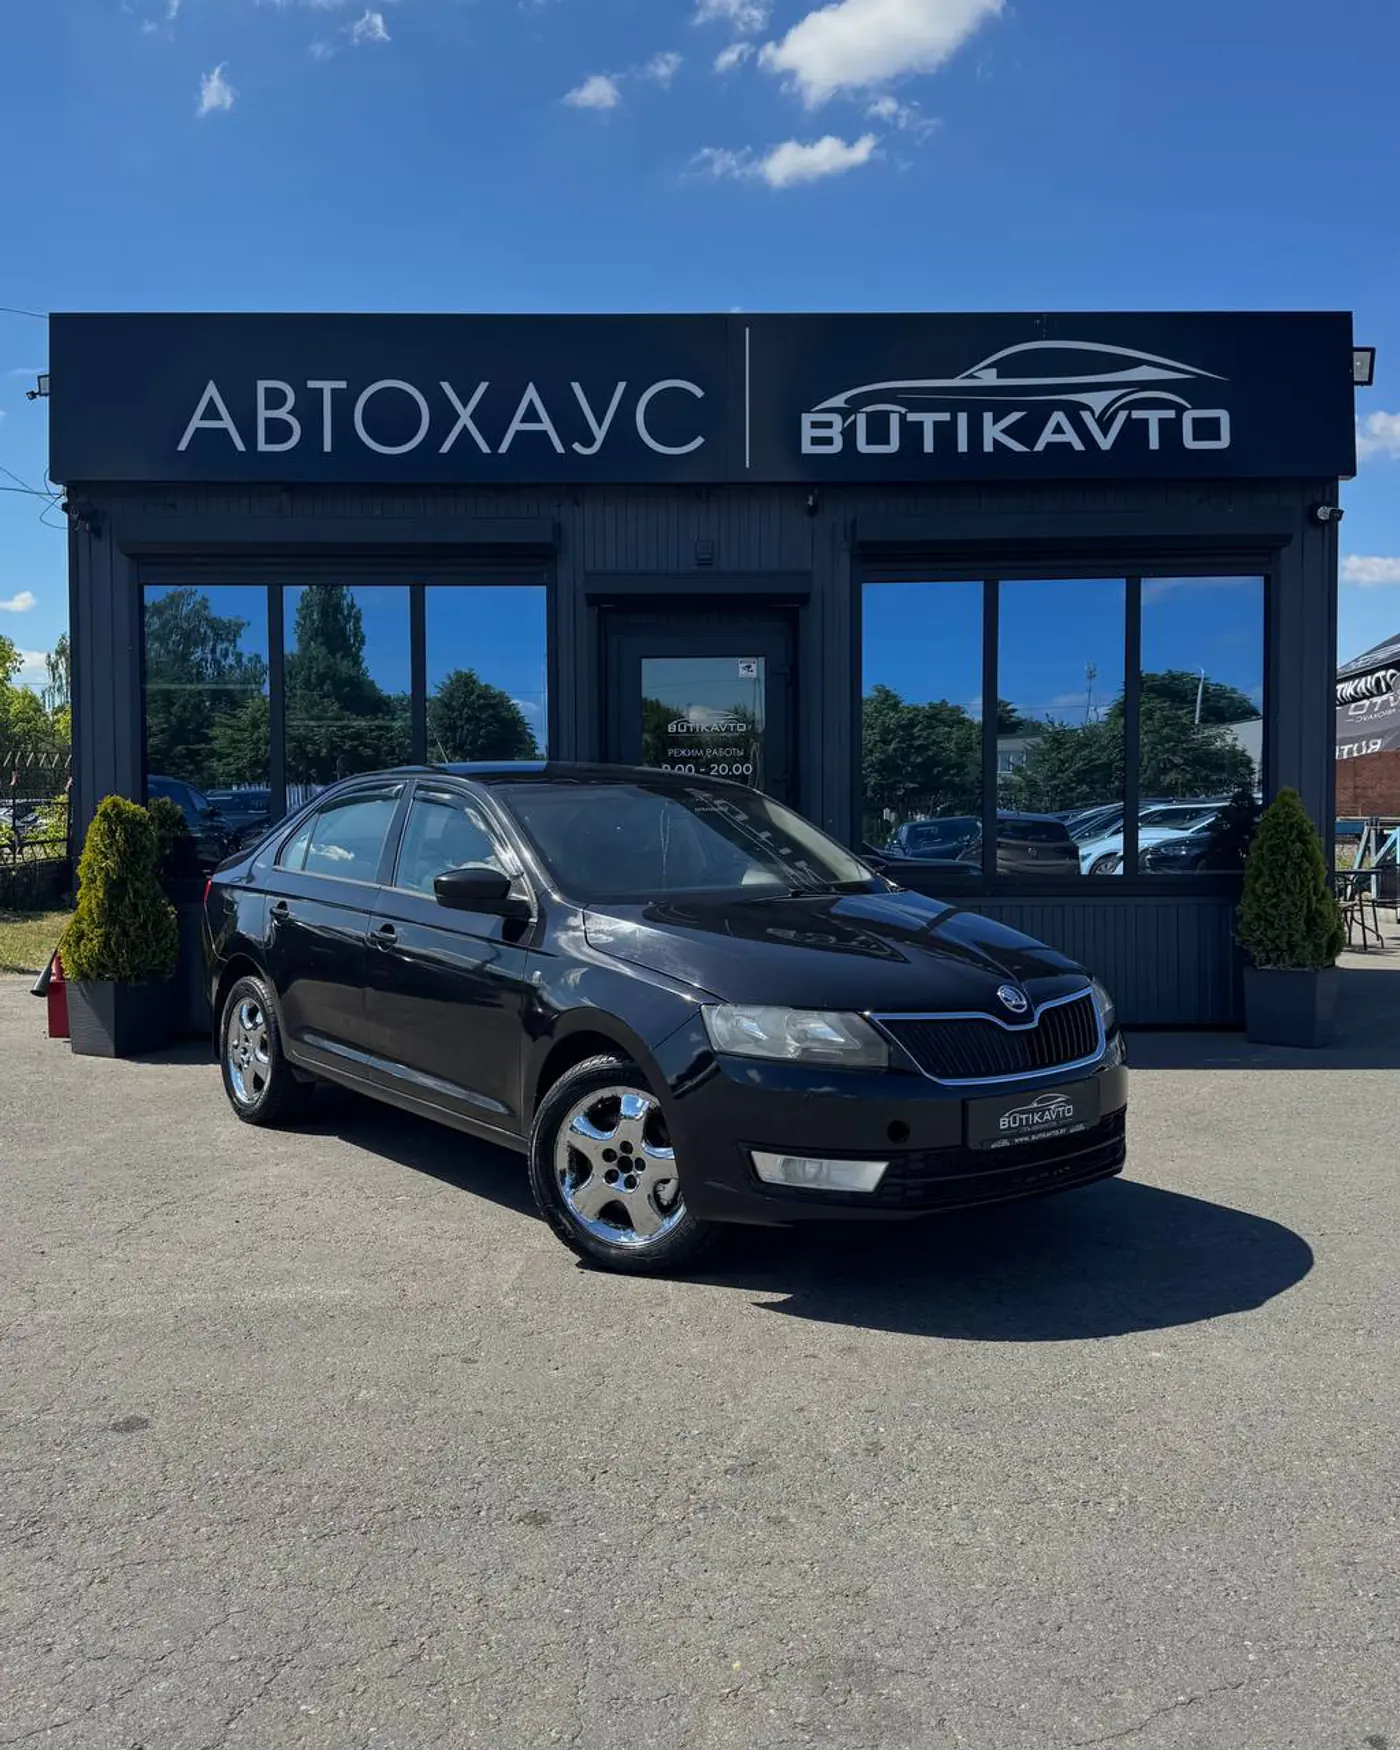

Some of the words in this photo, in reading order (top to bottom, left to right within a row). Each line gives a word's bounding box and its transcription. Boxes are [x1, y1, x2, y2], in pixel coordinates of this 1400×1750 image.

[176, 378, 706, 456] АВТОХАУС
[800, 407, 1231, 455] BUTIKAVTO
[667, 722, 747, 733] BUTIKAVTO
[667, 748, 703, 758] РЕЖИМ
[705, 748, 744, 758] РАБОТЫ
[709, 763, 753, 776] 20.00
[999, 1104, 1074, 1130] BUTIKAVTO
